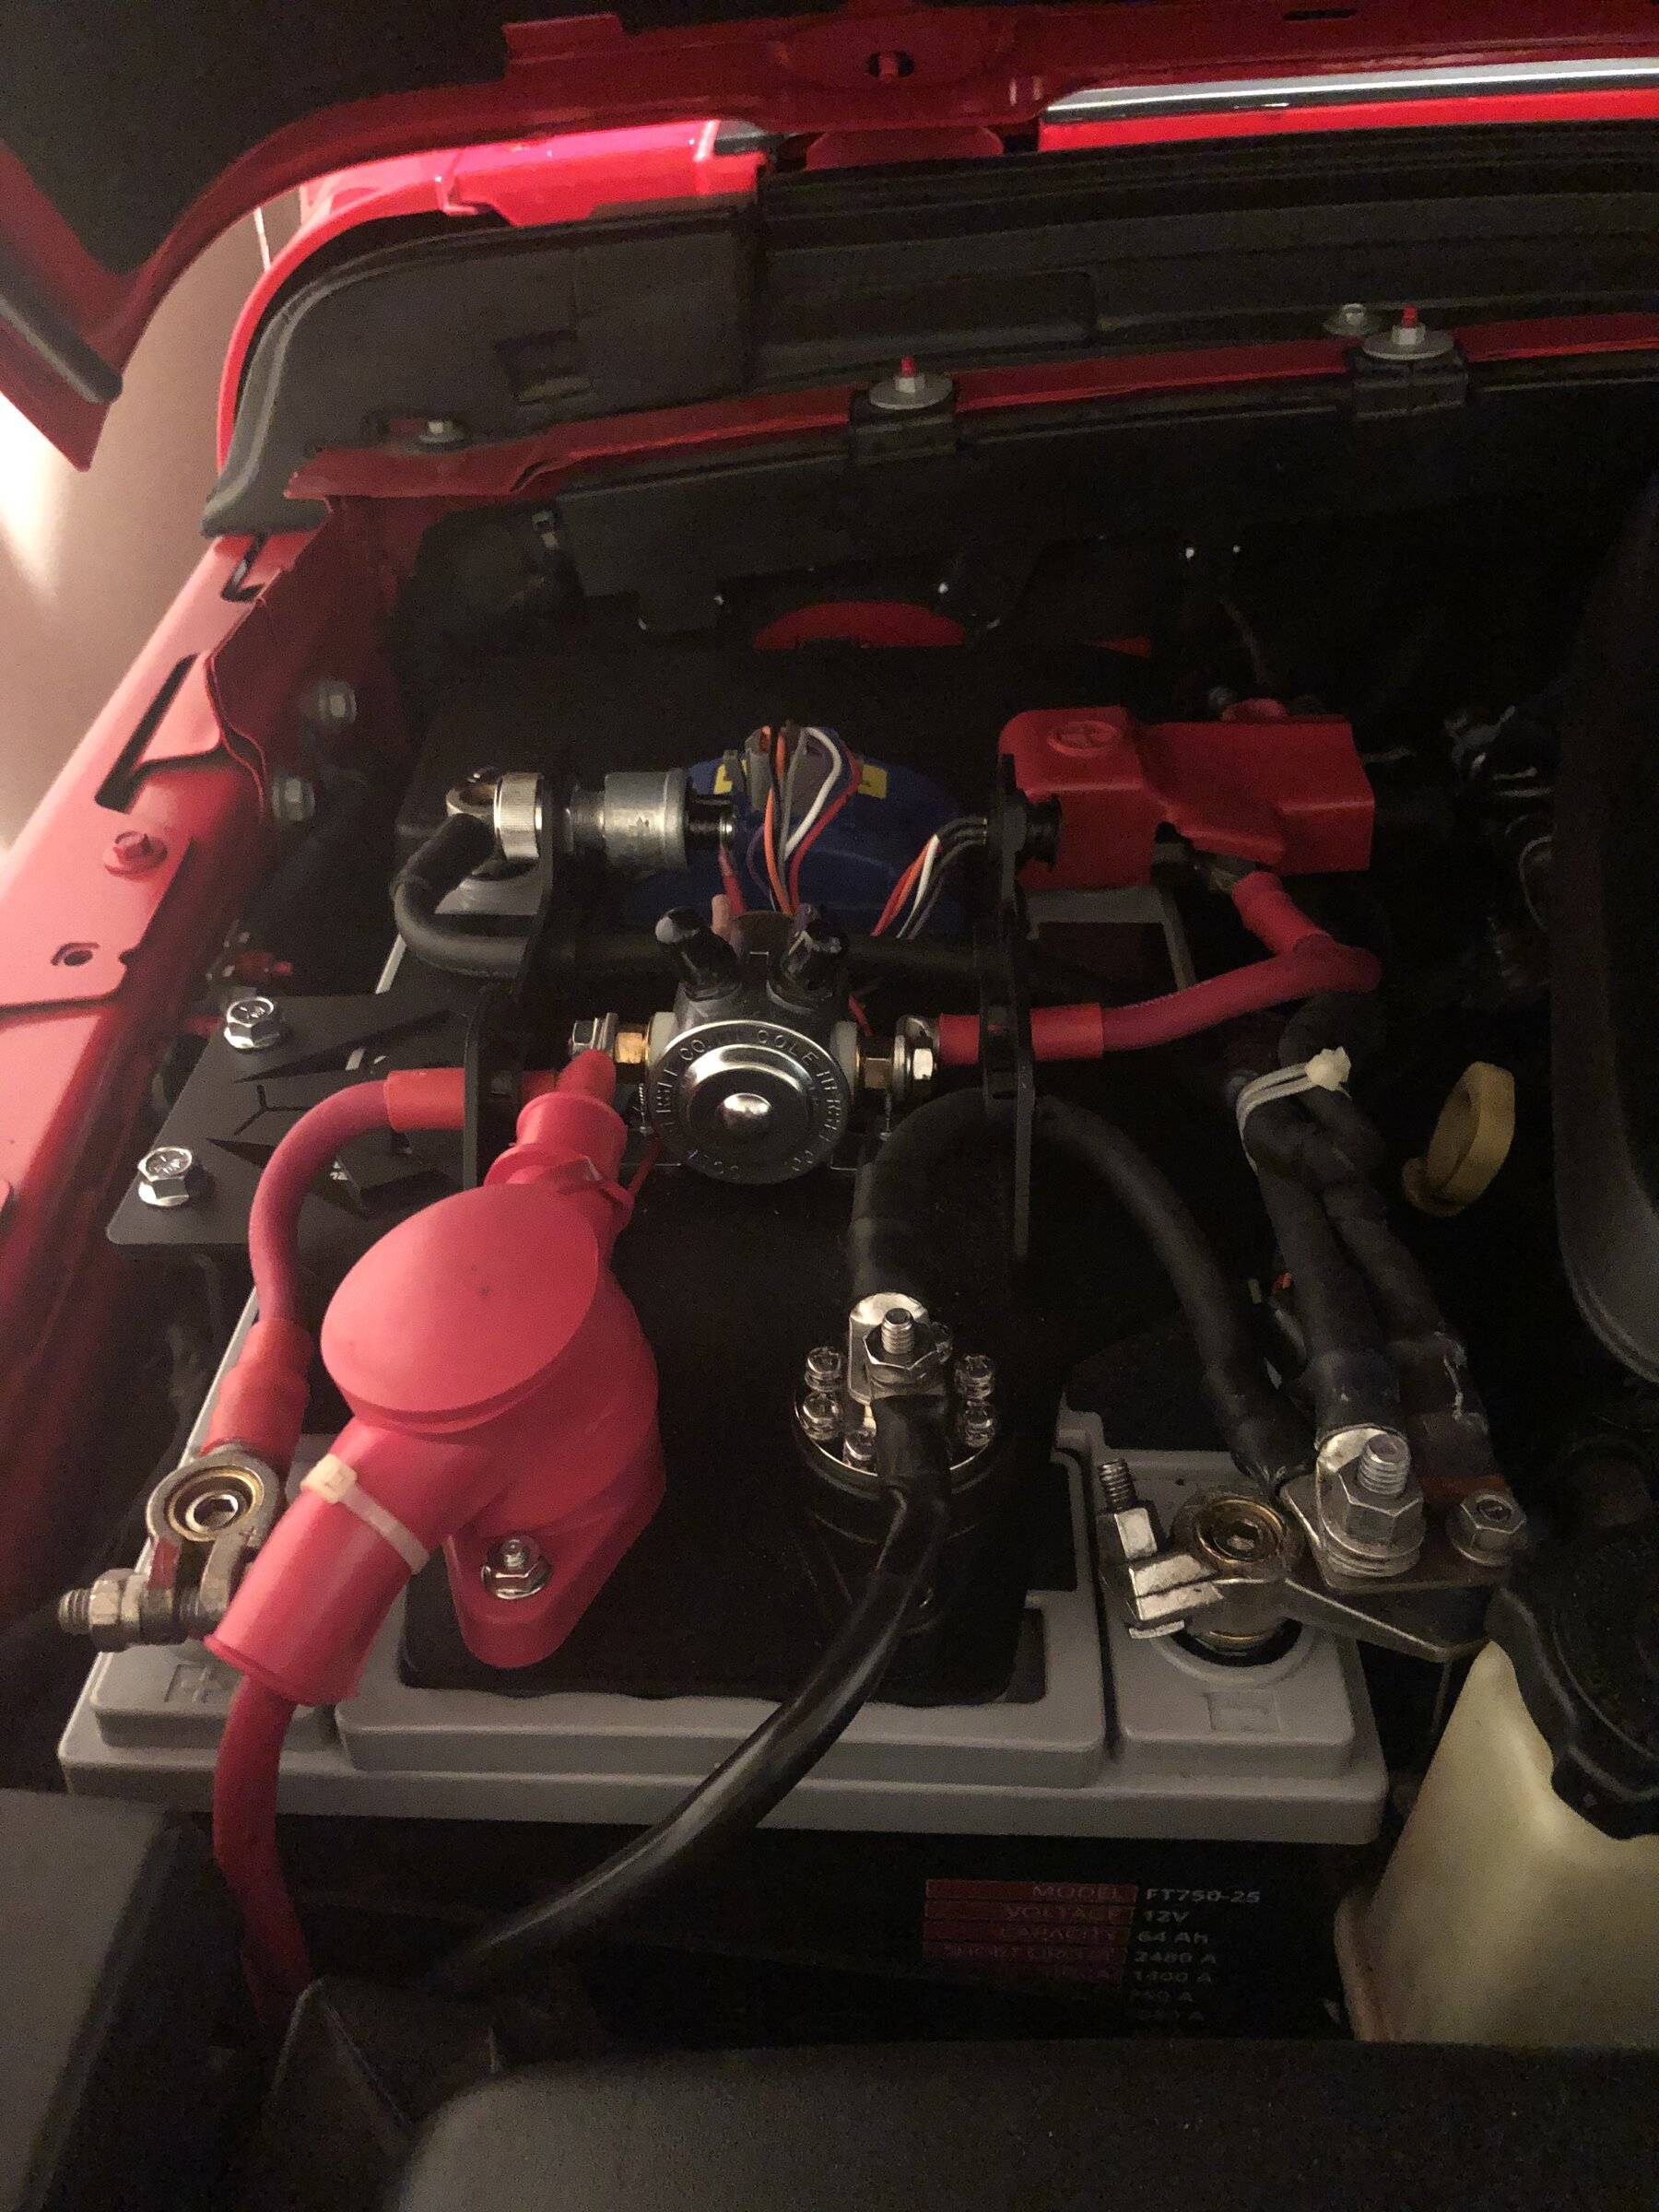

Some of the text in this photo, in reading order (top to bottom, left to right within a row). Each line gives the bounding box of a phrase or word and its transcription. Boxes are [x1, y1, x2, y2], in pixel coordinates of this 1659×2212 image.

[757, 1029, 820, 1066] COLE
[1032, 1885, 1261, 1903] MODEL FT750-25
[1143, 1910, 1191, 1924] 12V
[1200, 1953, 1217, 1964] A
